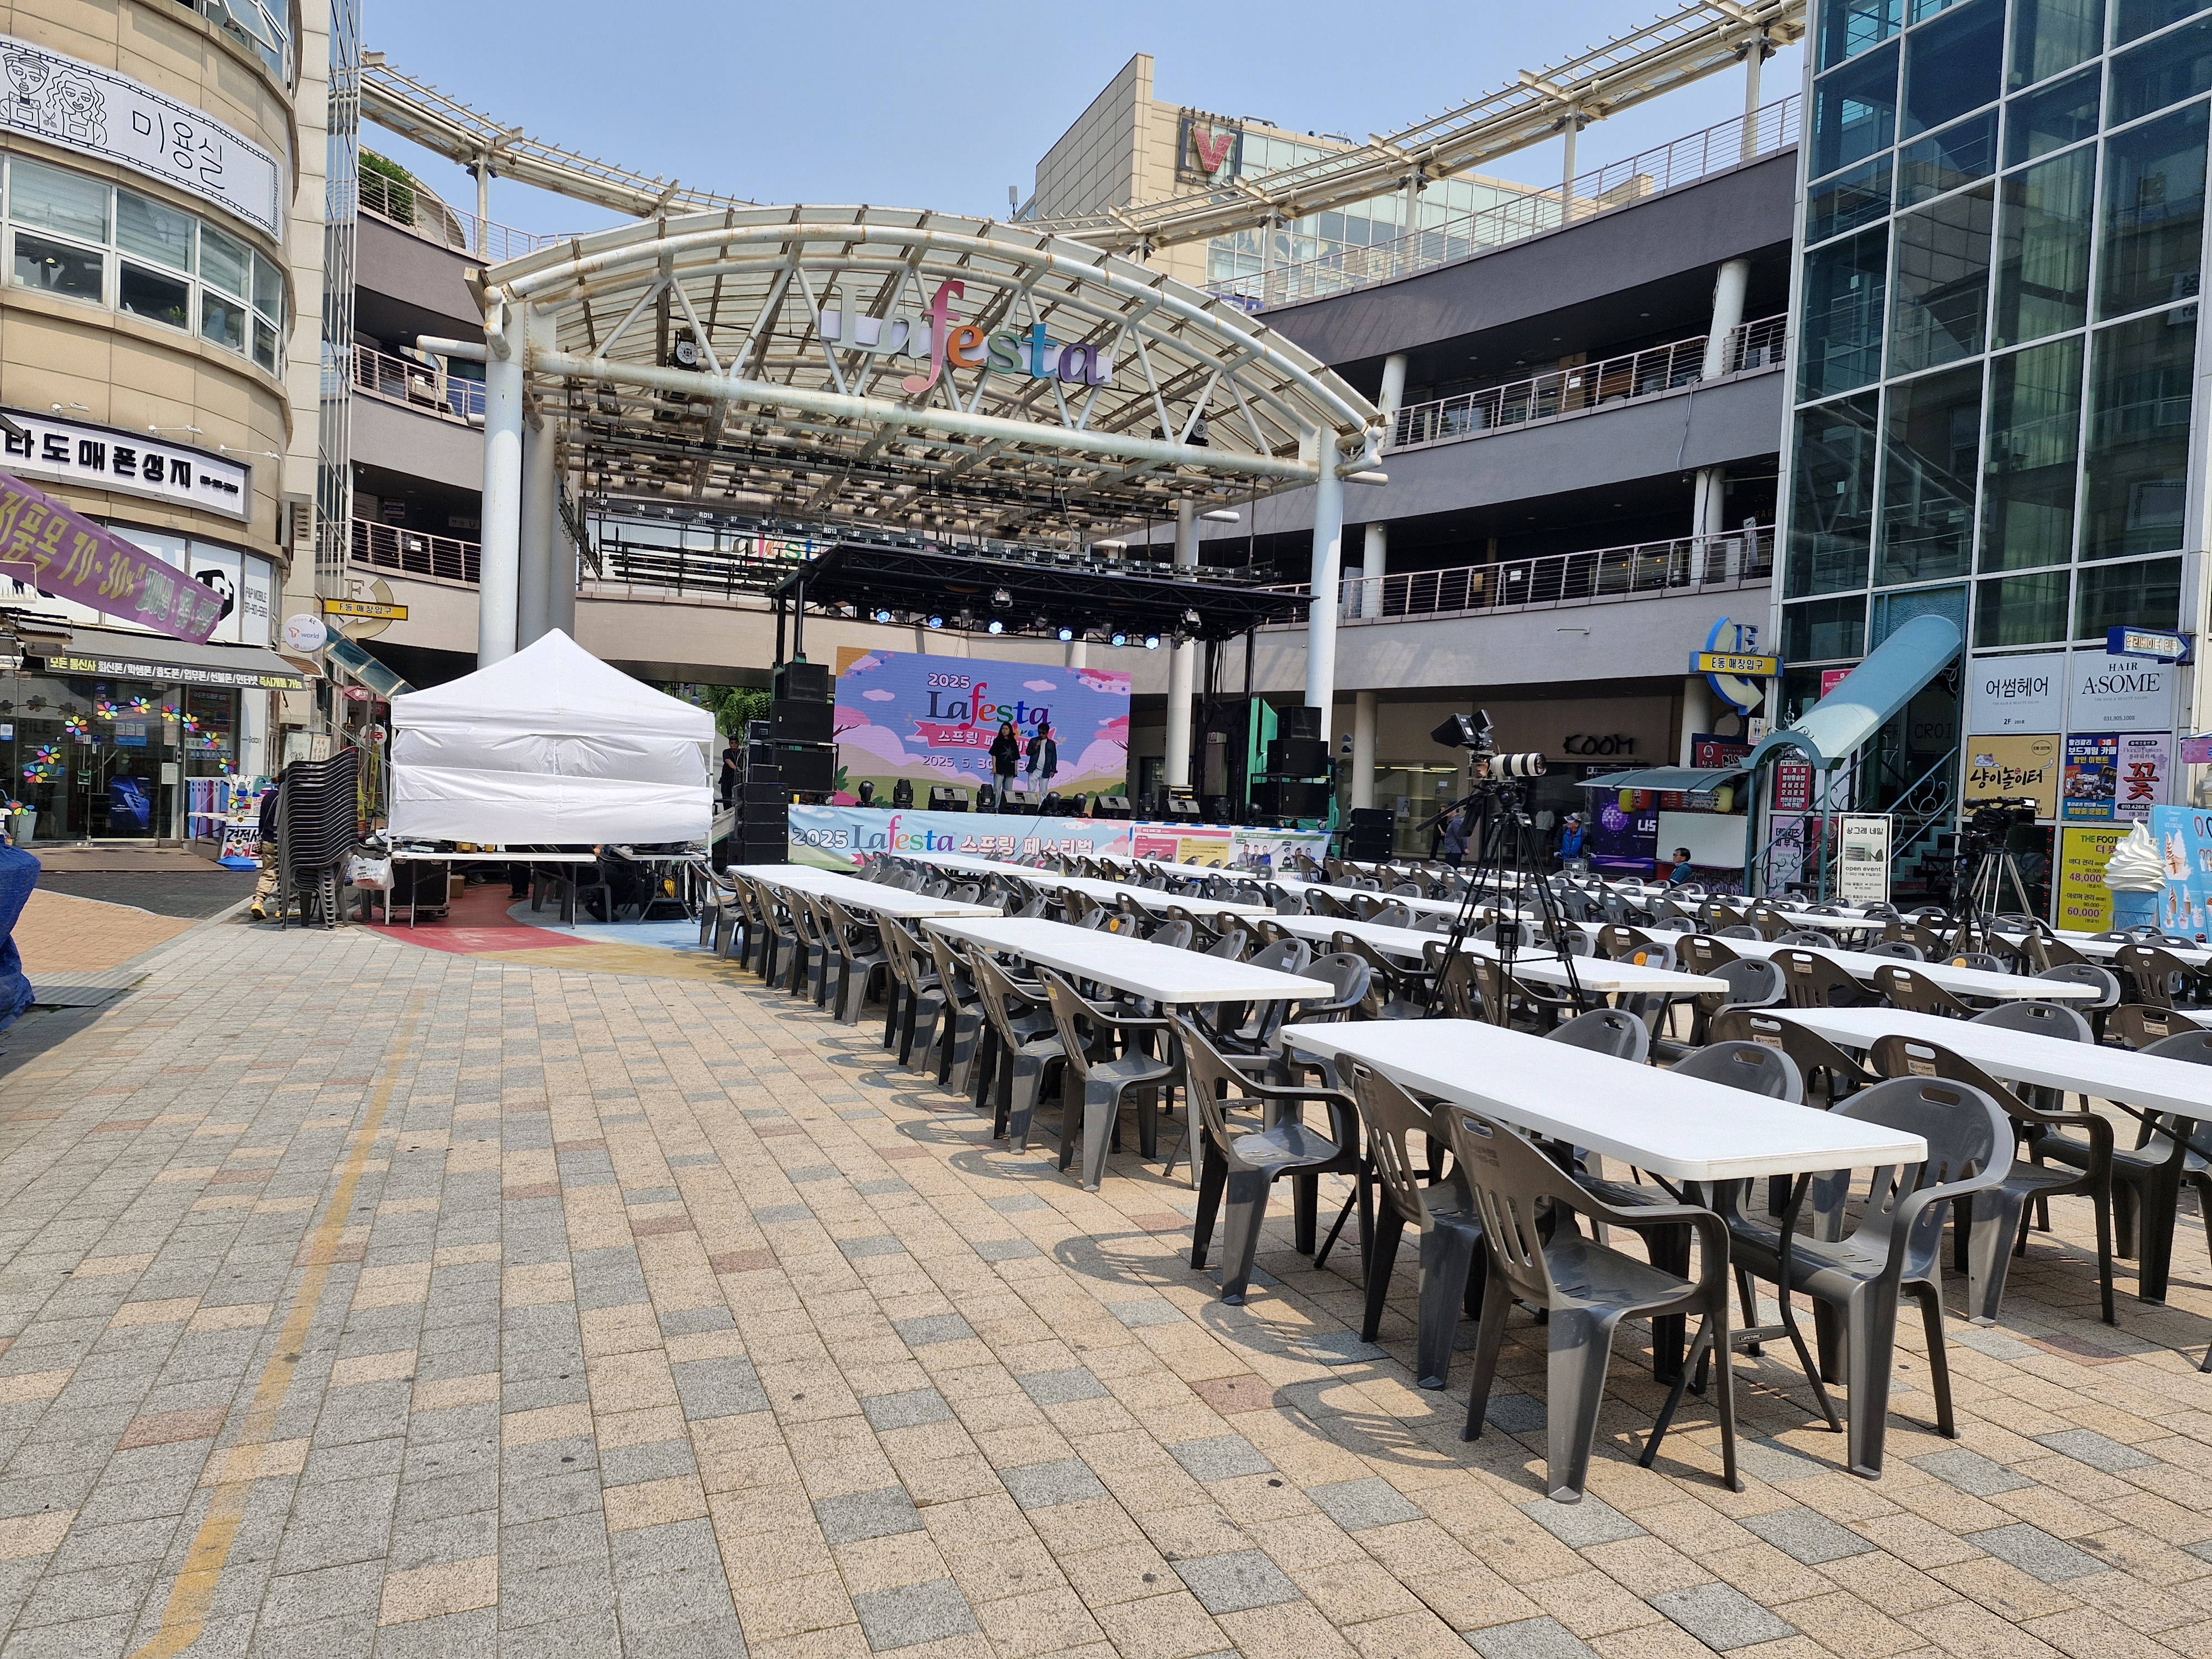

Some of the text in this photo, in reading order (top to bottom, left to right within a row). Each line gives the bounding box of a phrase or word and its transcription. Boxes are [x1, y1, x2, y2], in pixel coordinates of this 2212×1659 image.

[132, 109, 226, 191] 미용실
[830, 281, 1105, 393] Lafesta
[344, 578, 364, 601] F
[340, 603, 392, 614] F동 매장입구
[1735, 624, 1759, 654] E
[2125, 634, 2178, 652] 엘리베이터 입구
[1712, 657, 1763, 670] E동 매장입구
[2109, 662, 2138, 672] HAIR
[50, 657, 67, 669] 모든
[70, 658, 96, 671] 통신사
[288, 679, 302, 689] 가능
[927, 672, 971, 688] 2025
[1986, 676, 2048, 698] 어썸헤어
[926, 682, 1051, 730] Lafesta
[249, 736, 262, 747] Galaxy
[938, 730, 979, 745] 스프링
[2068, 747, 2117, 755] 보드게임 카페
[922, 755, 957, 768] 2025.
[962, 758, 973, 769] 5.
[1970, 766, 2043, 790] 냥이놀이터
[2123, 762, 2160, 801] 꽃
[791, 815, 1094, 856] 2025 Lafesta 스프링 페스티벌
[1869, 827, 1884, 835] 네일
[2097, 836, 2119, 844] FOOT
[2095, 844, 2105, 854] 더
[2069, 873, 2101, 883] 48,000
[2067, 907, 2100, 917] 60,000
